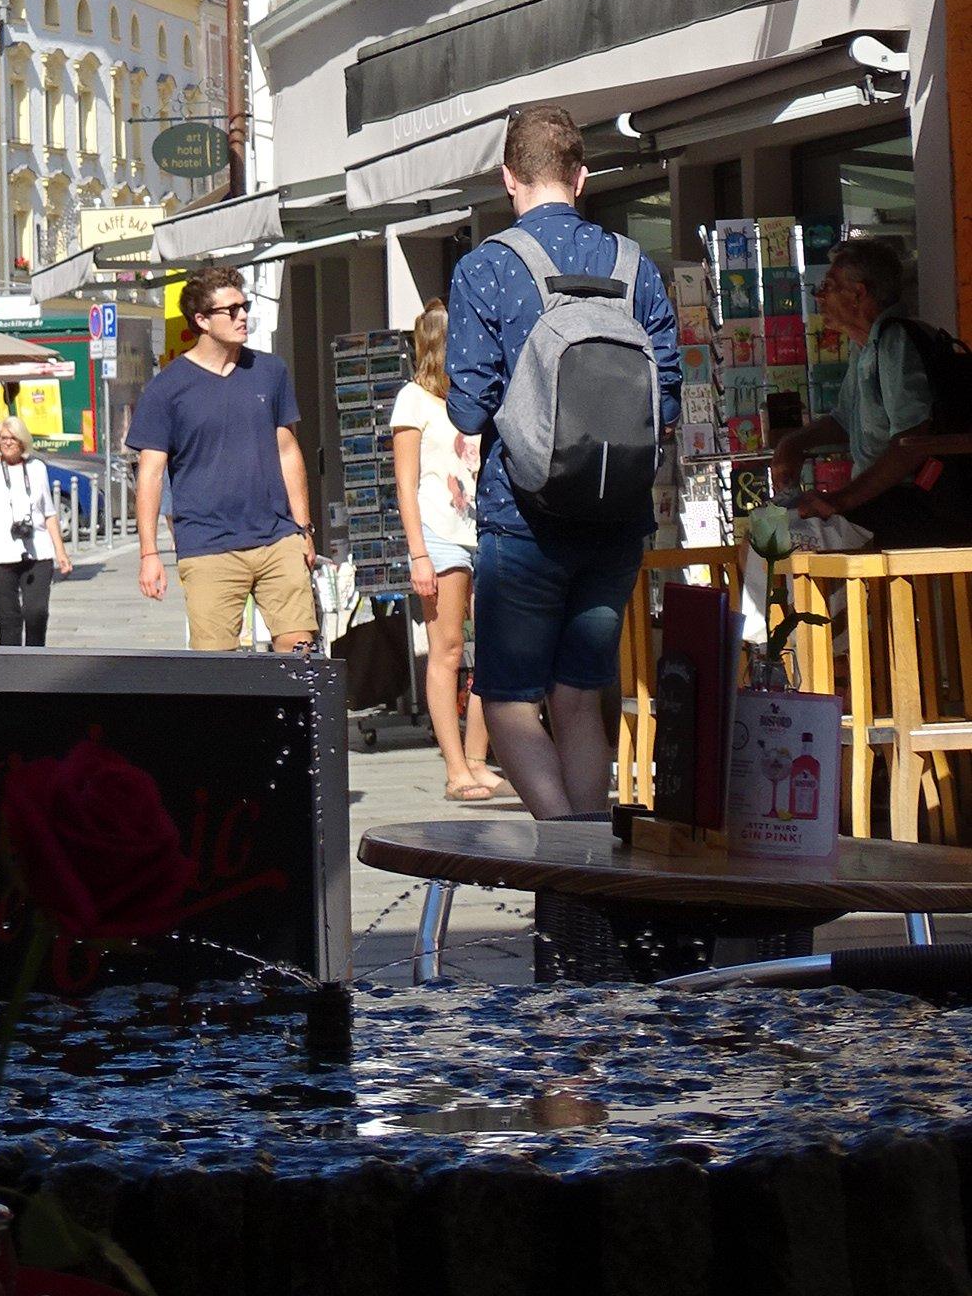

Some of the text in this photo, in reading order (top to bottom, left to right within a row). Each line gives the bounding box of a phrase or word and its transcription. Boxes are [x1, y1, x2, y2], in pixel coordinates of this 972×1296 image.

[186, 133, 202, 142] art
[177, 145, 202, 155] hotel
[161, 158, 202, 168] & hostel
[128, 216, 148, 233] BAR
